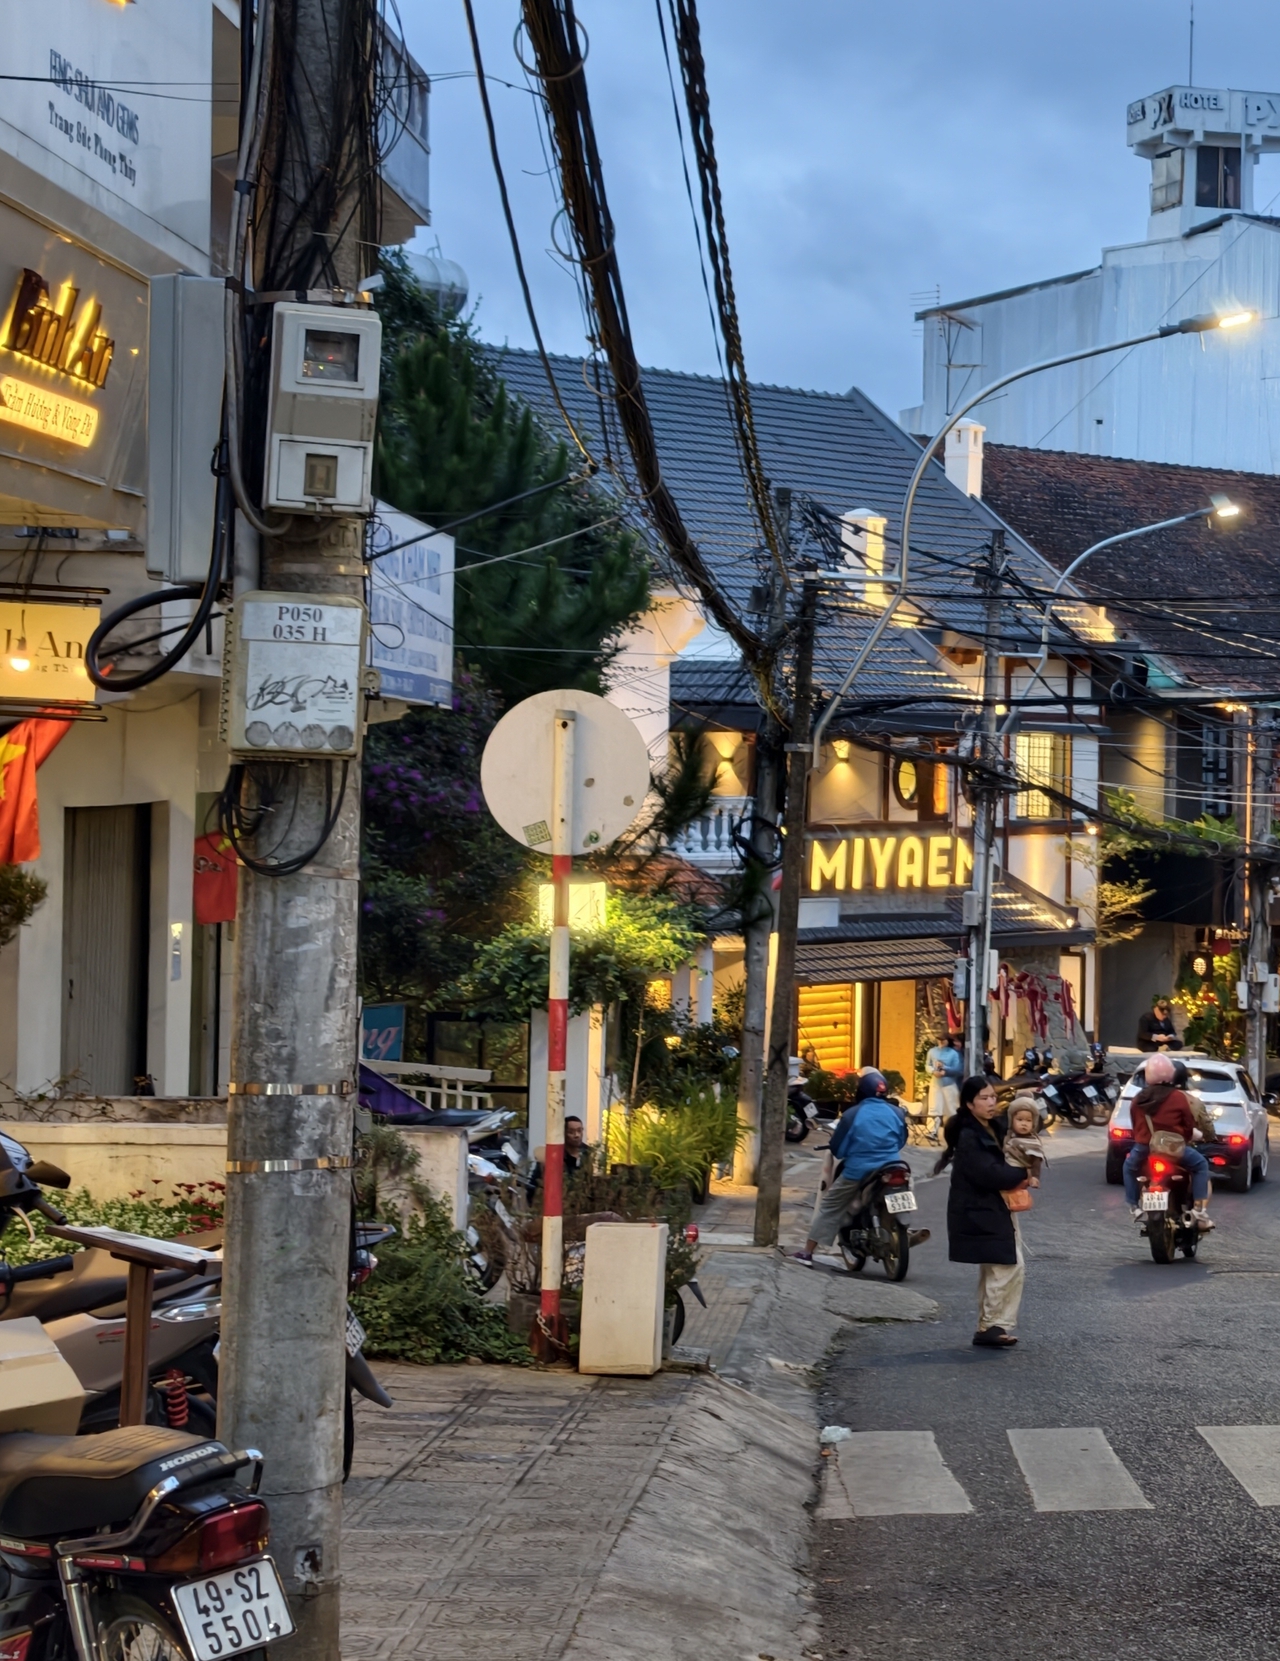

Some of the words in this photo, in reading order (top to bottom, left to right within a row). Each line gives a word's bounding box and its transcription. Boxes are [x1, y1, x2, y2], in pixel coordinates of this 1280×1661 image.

[1180, 92, 1224, 111] HOTEL
[278, 606, 323, 622] P050
[273, 624, 306, 640] 035
[313, 626, 327, 641] H
[159, 1446, 219, 1471] HONDA
[202, 1605, 281, 1654] 5504
